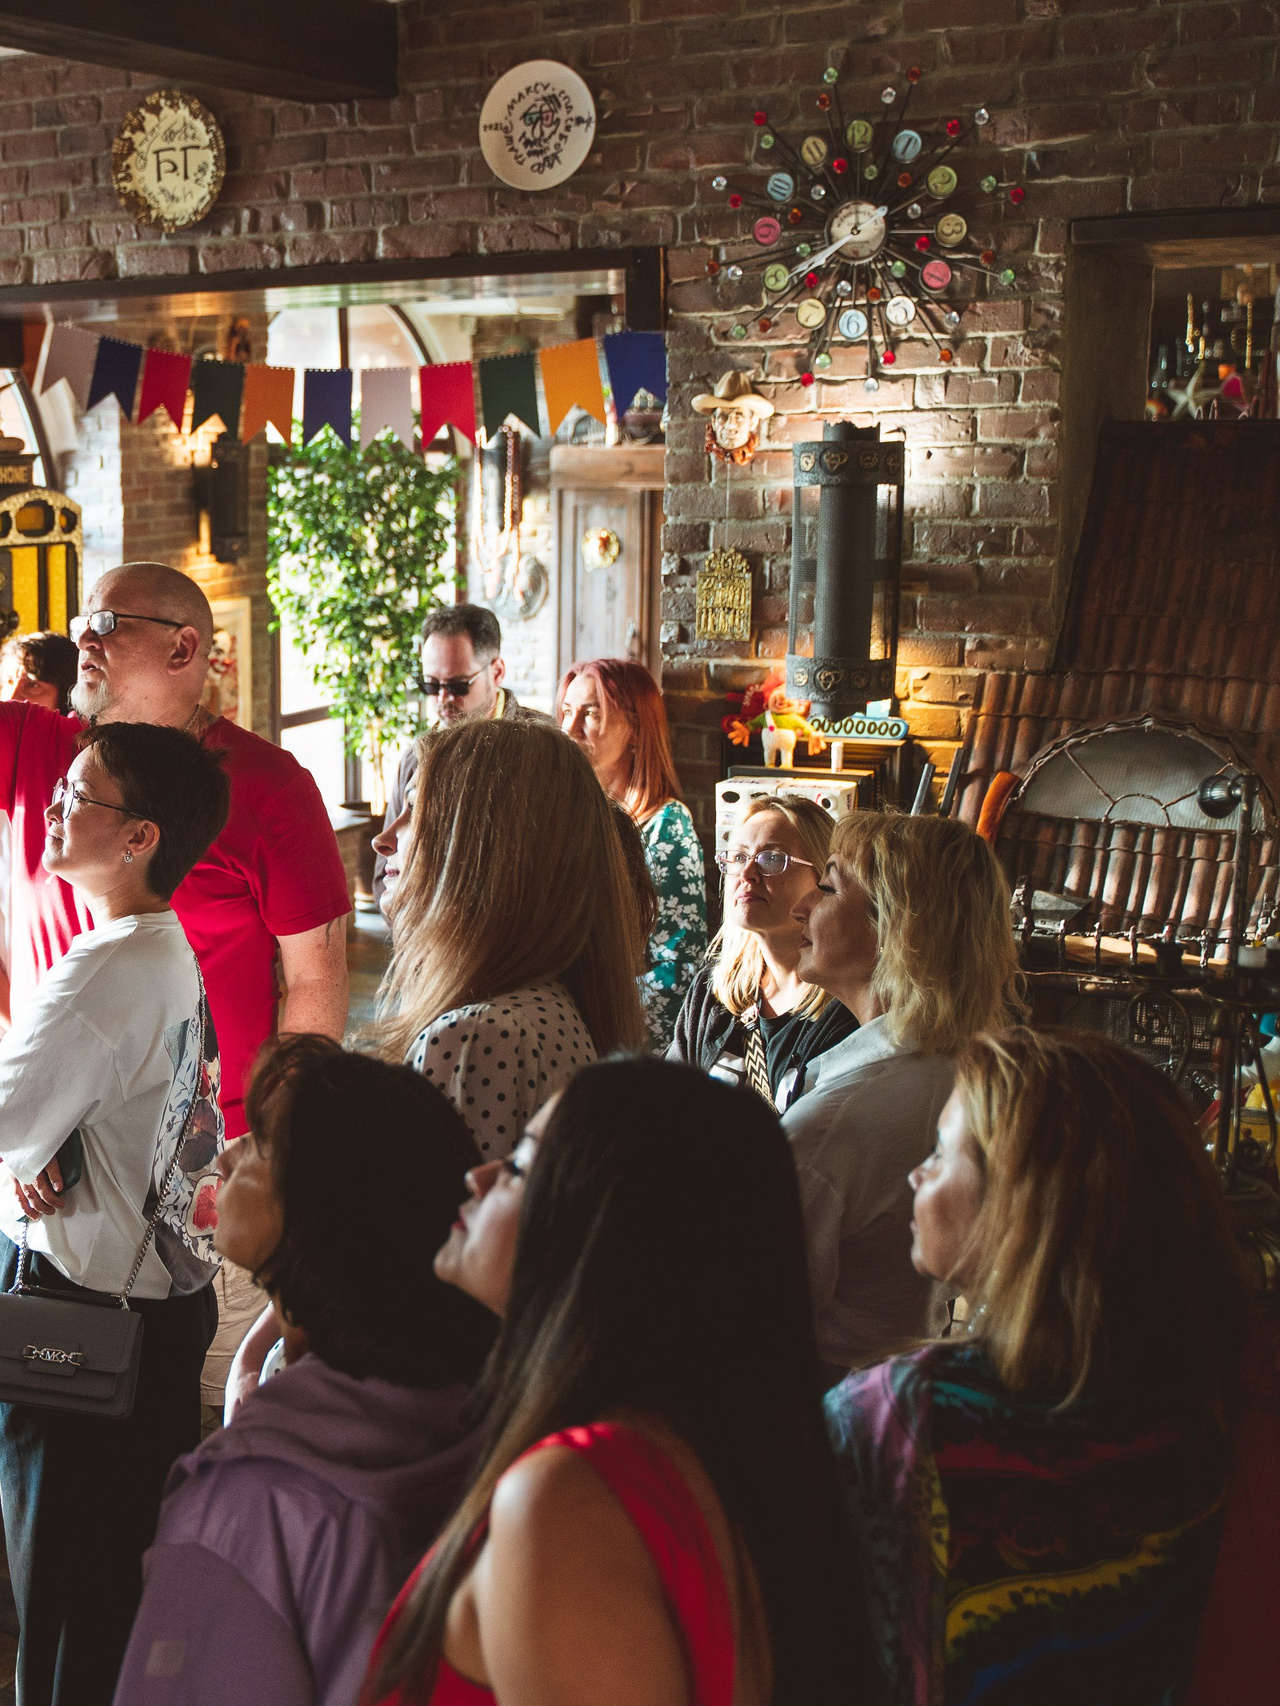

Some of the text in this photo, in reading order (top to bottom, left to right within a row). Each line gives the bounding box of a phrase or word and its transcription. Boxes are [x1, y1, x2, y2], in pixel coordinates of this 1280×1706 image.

[851, 121, 869, 148] 12
[807, 140, 824, 163] 11
[772, 177, 791, 198] 10
[932, 172, 952, 191] 2
[757, 222, 777, 238] 9
[941, 222, 962, 237] 3
[769, 269, 786, 287] 8
[803, 303, 821, 322] 7
[892, 301, 908, 322] 5
[846, 313, 861, 335] 6
[46, 1350, 60, 1361] MK
